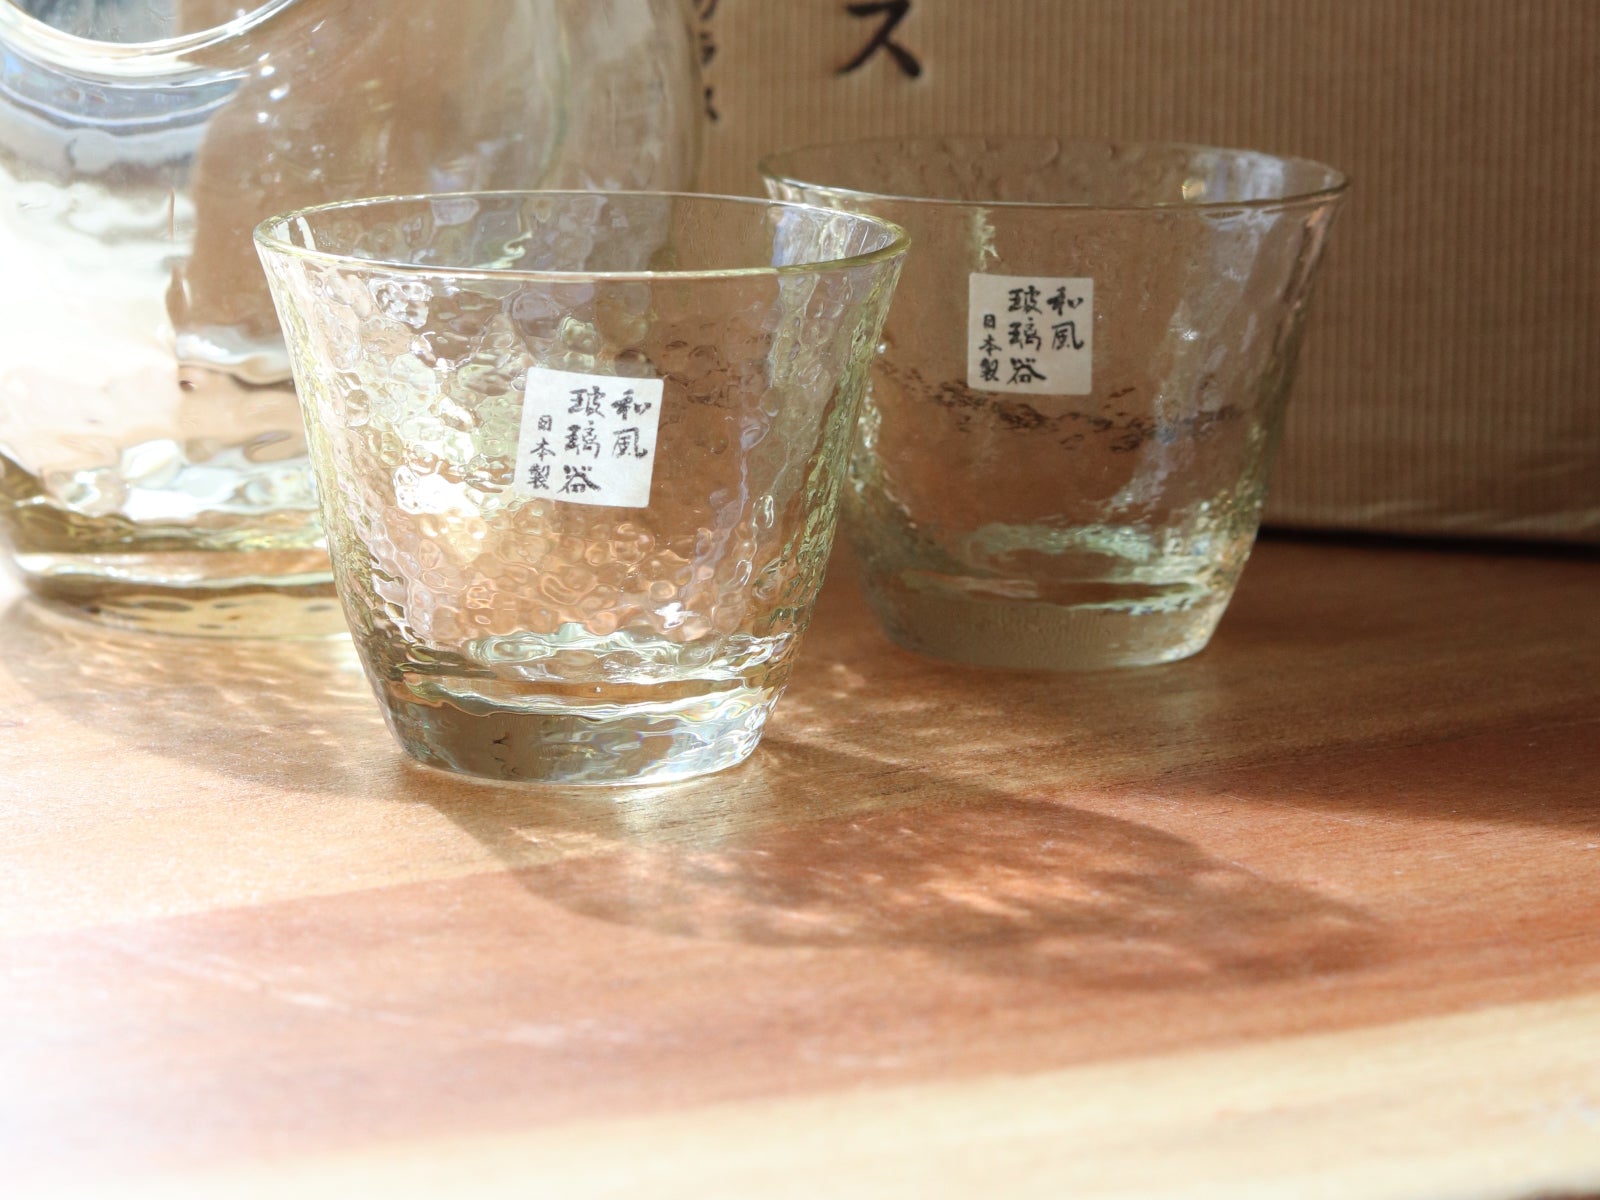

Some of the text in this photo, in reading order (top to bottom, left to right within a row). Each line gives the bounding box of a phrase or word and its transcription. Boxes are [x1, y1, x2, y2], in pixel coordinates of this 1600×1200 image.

[979, 314, 1002, 382] 日本製
[1047, 286, 1084, 350] 和風
[528, 414, 556, 490] 日本製
[611, 389, 651, 459] 和風
